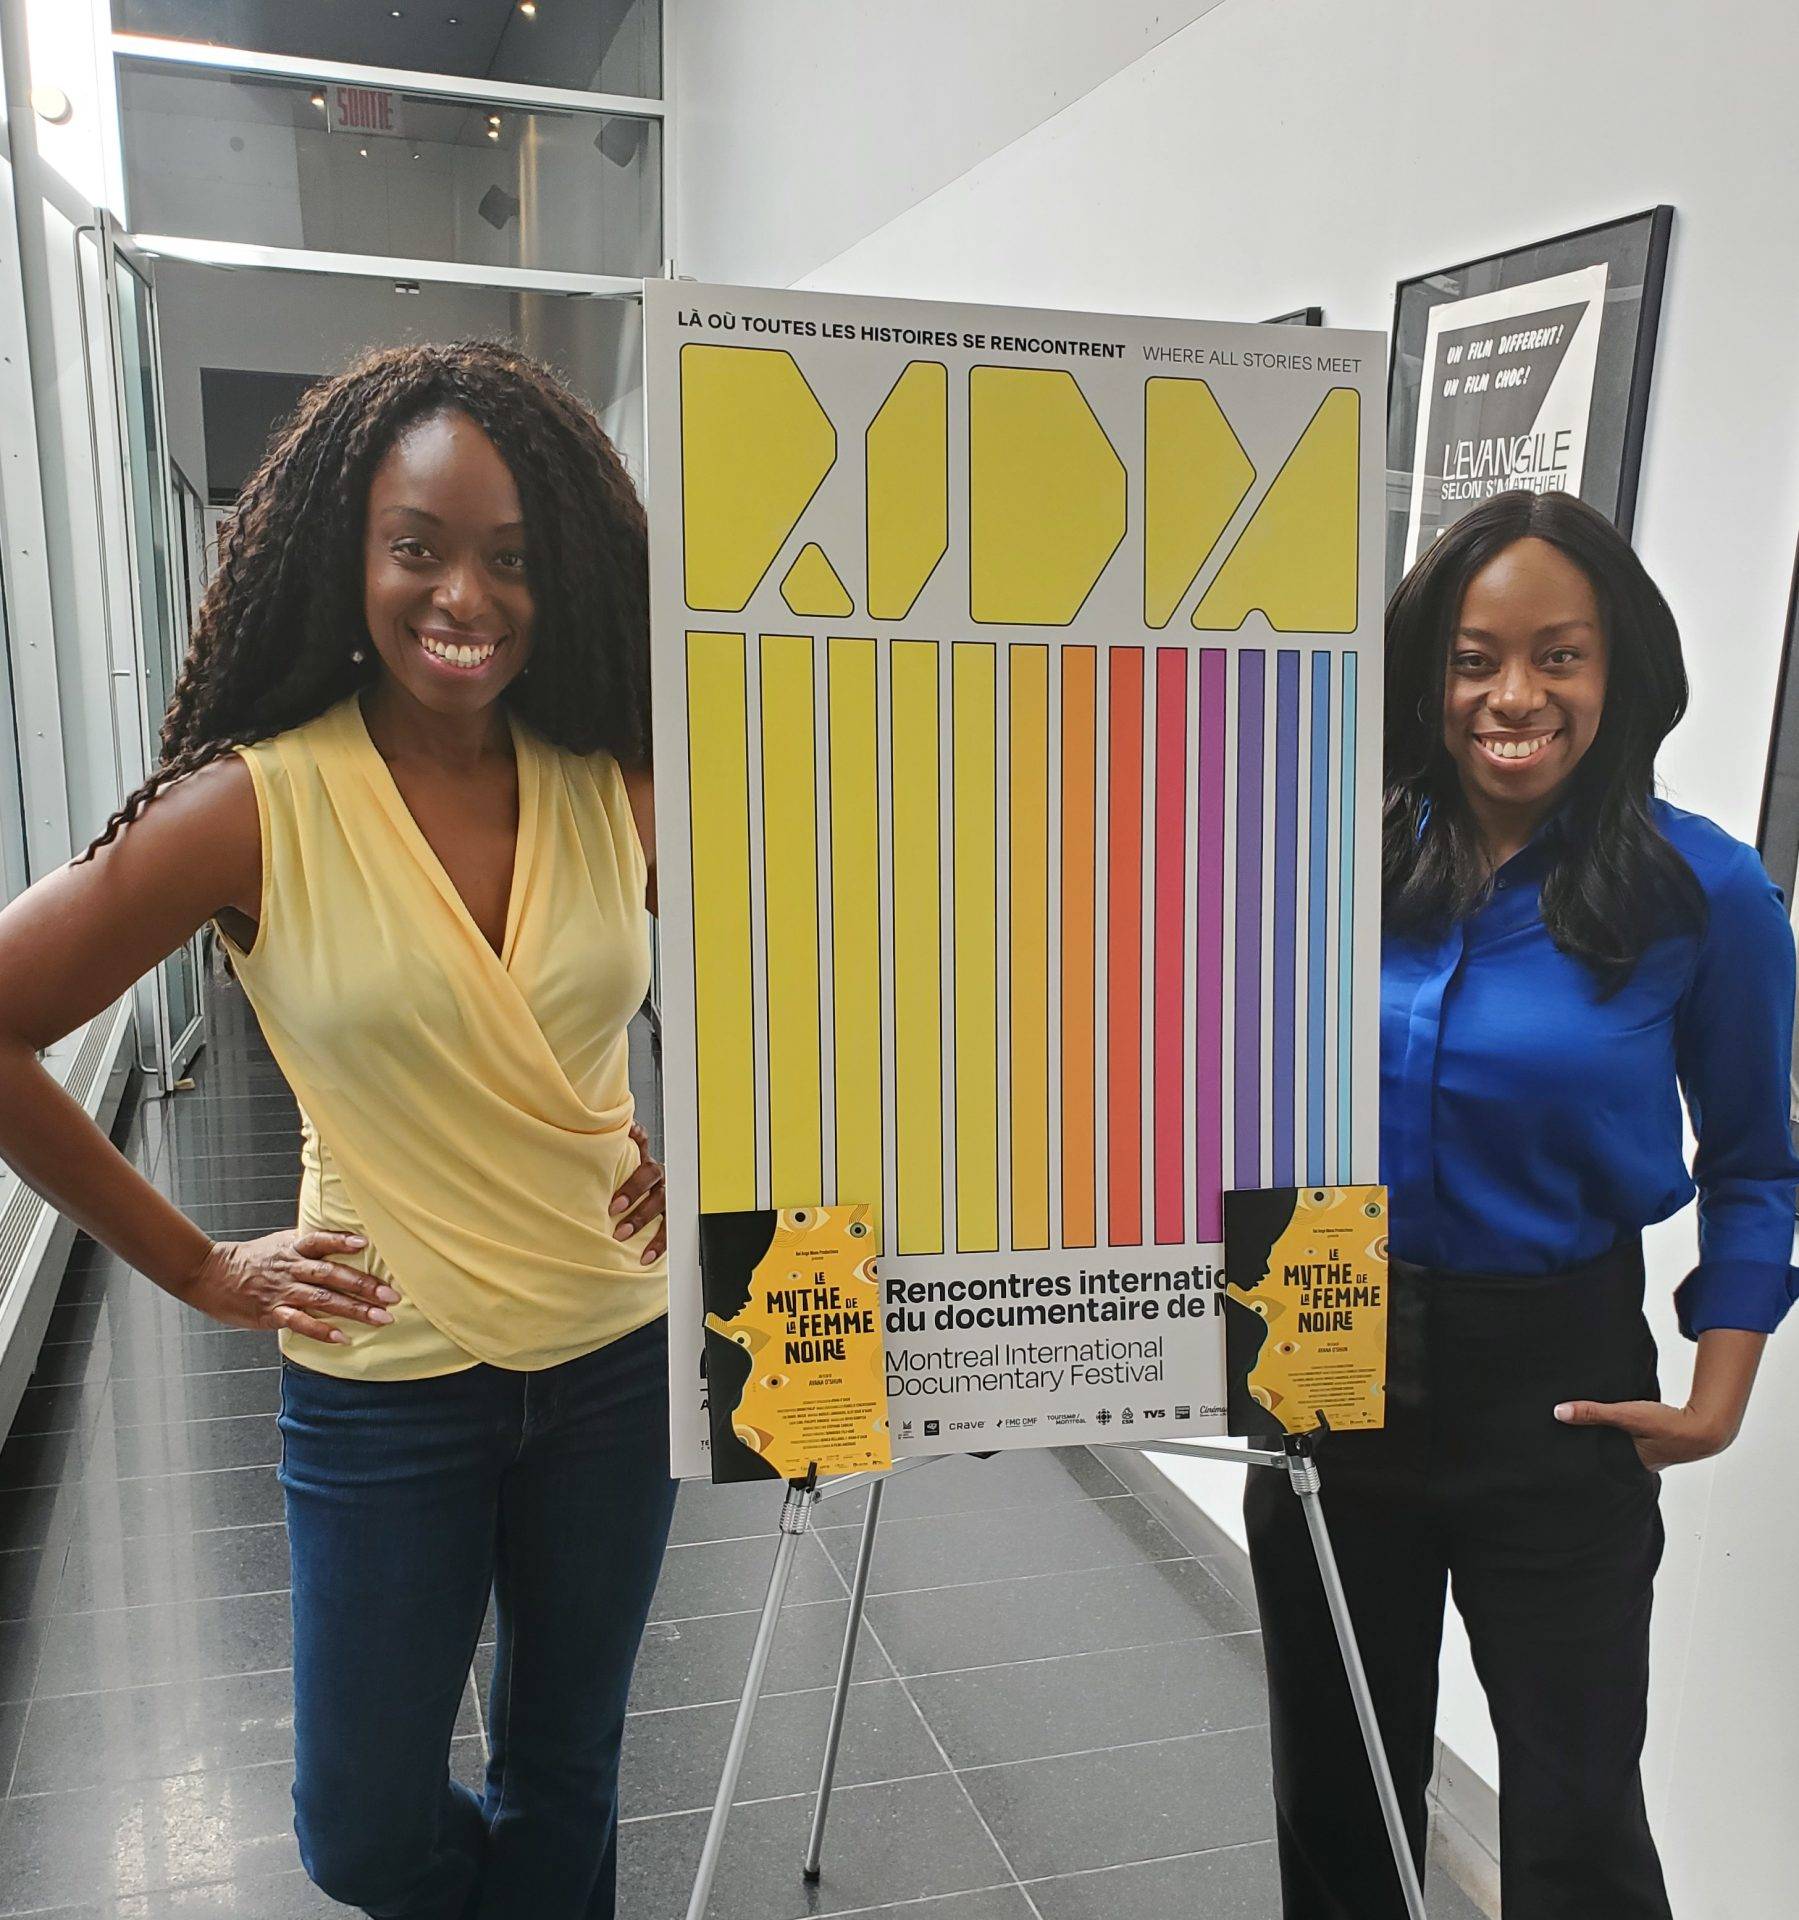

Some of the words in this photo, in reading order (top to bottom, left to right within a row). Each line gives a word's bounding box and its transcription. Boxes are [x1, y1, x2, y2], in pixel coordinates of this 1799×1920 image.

[336, 87, 394, 130] SORTIE
[678, 309, 703, 327] LÀ
[708, 312, 736, 330] OÙ
[741, 316, 817, 337] TOUTES
[822, 323, 856, 339] LES
[861, 326, 957, 347] HISTOIRES
[963, 334, 985, 349] SE
[991, 336, 1126, 358] RENCONTRENT
[1446, 345, 1461, 365] UN
[1468, 338, 1493, 361] FILM
[1498, 324, 1565, 357] DIFFERENT!
[1143, 346, 1205, 363] WHERE
[1209, 351, 1238, 366] ALL
[1243, 352, 1312, 370] STORIES
[1317, 357, 1362, 373] MEET
[1443, 378, 1458, 398] UN
[1464, 372, 1488, 394] FILM
[1494, 364, 1532, 389] CHOC!
[1441, 480, 1481, 500] SELON
[1329, 1248, 1339, 1261] LE
[815, 1272, 826, 1285] LE
[886, 1272, 1071, 1304] Rencontres
[1284, 1263, 1352, 1290] MYTHE
[1356, 1273, 1368, 1284] DE
[767, 1287, 841, 1317] MYTHE
[846, 1298, 858, 1309] DE
[1313, 1286, 1381, 1309] FEMME
[800, 1311, 875, 1337] FEMME
[886, 1306, 926, 1334] du
[935, 1296, 1160, 1330] documentaire
[1168, 1293, 1205, 1319] de
[1298, 1310, 1353, 1333] NOIRE
[785, 1338, 847, 1364] NOIRE
[886, 1344, 999, 1373] Montreal
[1007, 1336, 1163, 1365] International
[887, 1369, 1065, 1397] Documentary
[1071, 1360, 1164, 1386] Festival
[1143, 1409, 1166, 1419] TV5
